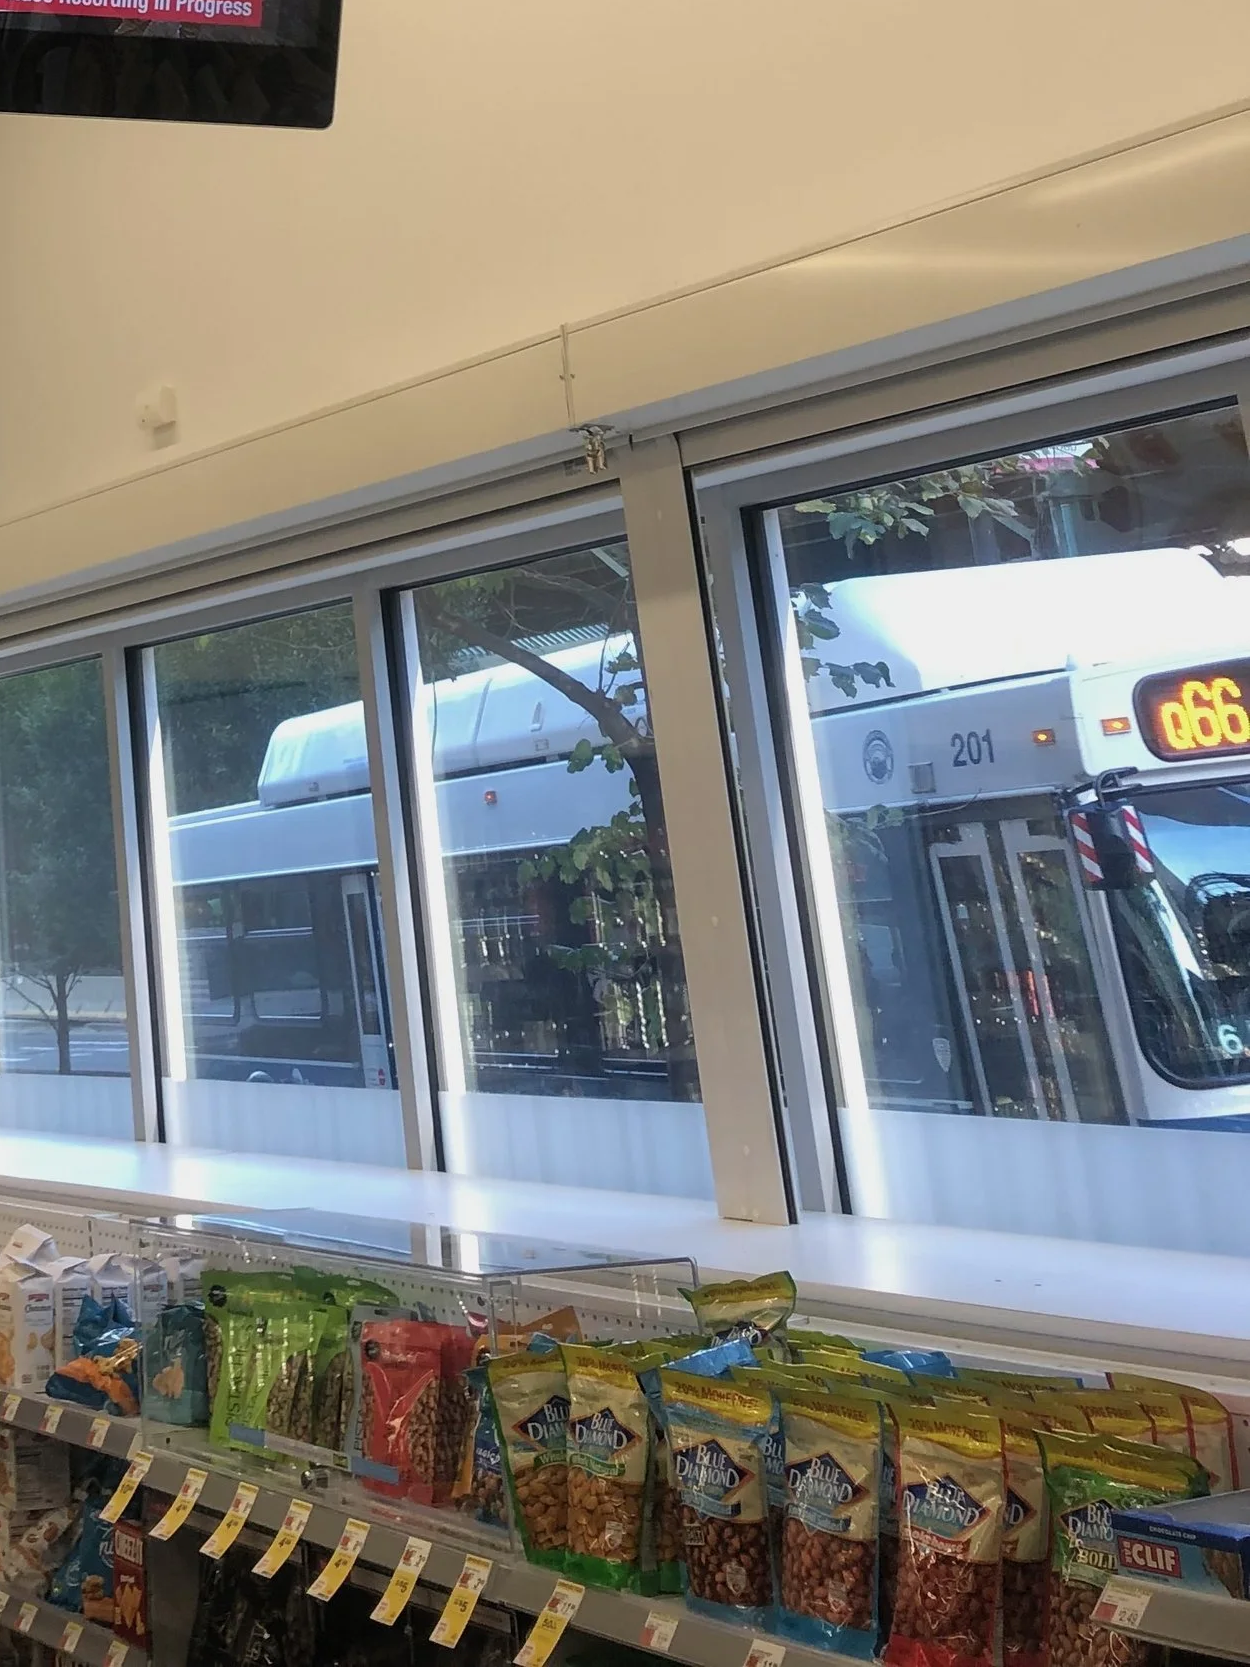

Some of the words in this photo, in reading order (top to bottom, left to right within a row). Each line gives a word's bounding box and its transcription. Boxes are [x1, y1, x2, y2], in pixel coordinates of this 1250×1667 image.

[1160, 678, 1250, 751] Q66
[950, 728, 995, 768] 201
[543, 1403, 570, 1423] BLU
[590, 1412, 615, 1432] BLUE
[576, 1424, 628, 1450] DIAMOND
[763, 1436, 784, 1460] BLU
[695, 1444, 727, 1469] BLUE
[676, 1455, 739, 1488] DIAMOND
[810, 1458, 842, 1485] BLUE
[789, 1469, 853, 1503] DIAMOND
[903, 1489, 980, 1527] DIAMOND
[1069, 1516, 1114, 1541] DIAMO
[1149, 1525, 1181, 1539] CHOCOLATE
[1181, 1531, 1197, 1540] CHIP
[1132, 1543, 1176, 1572] CLIF
